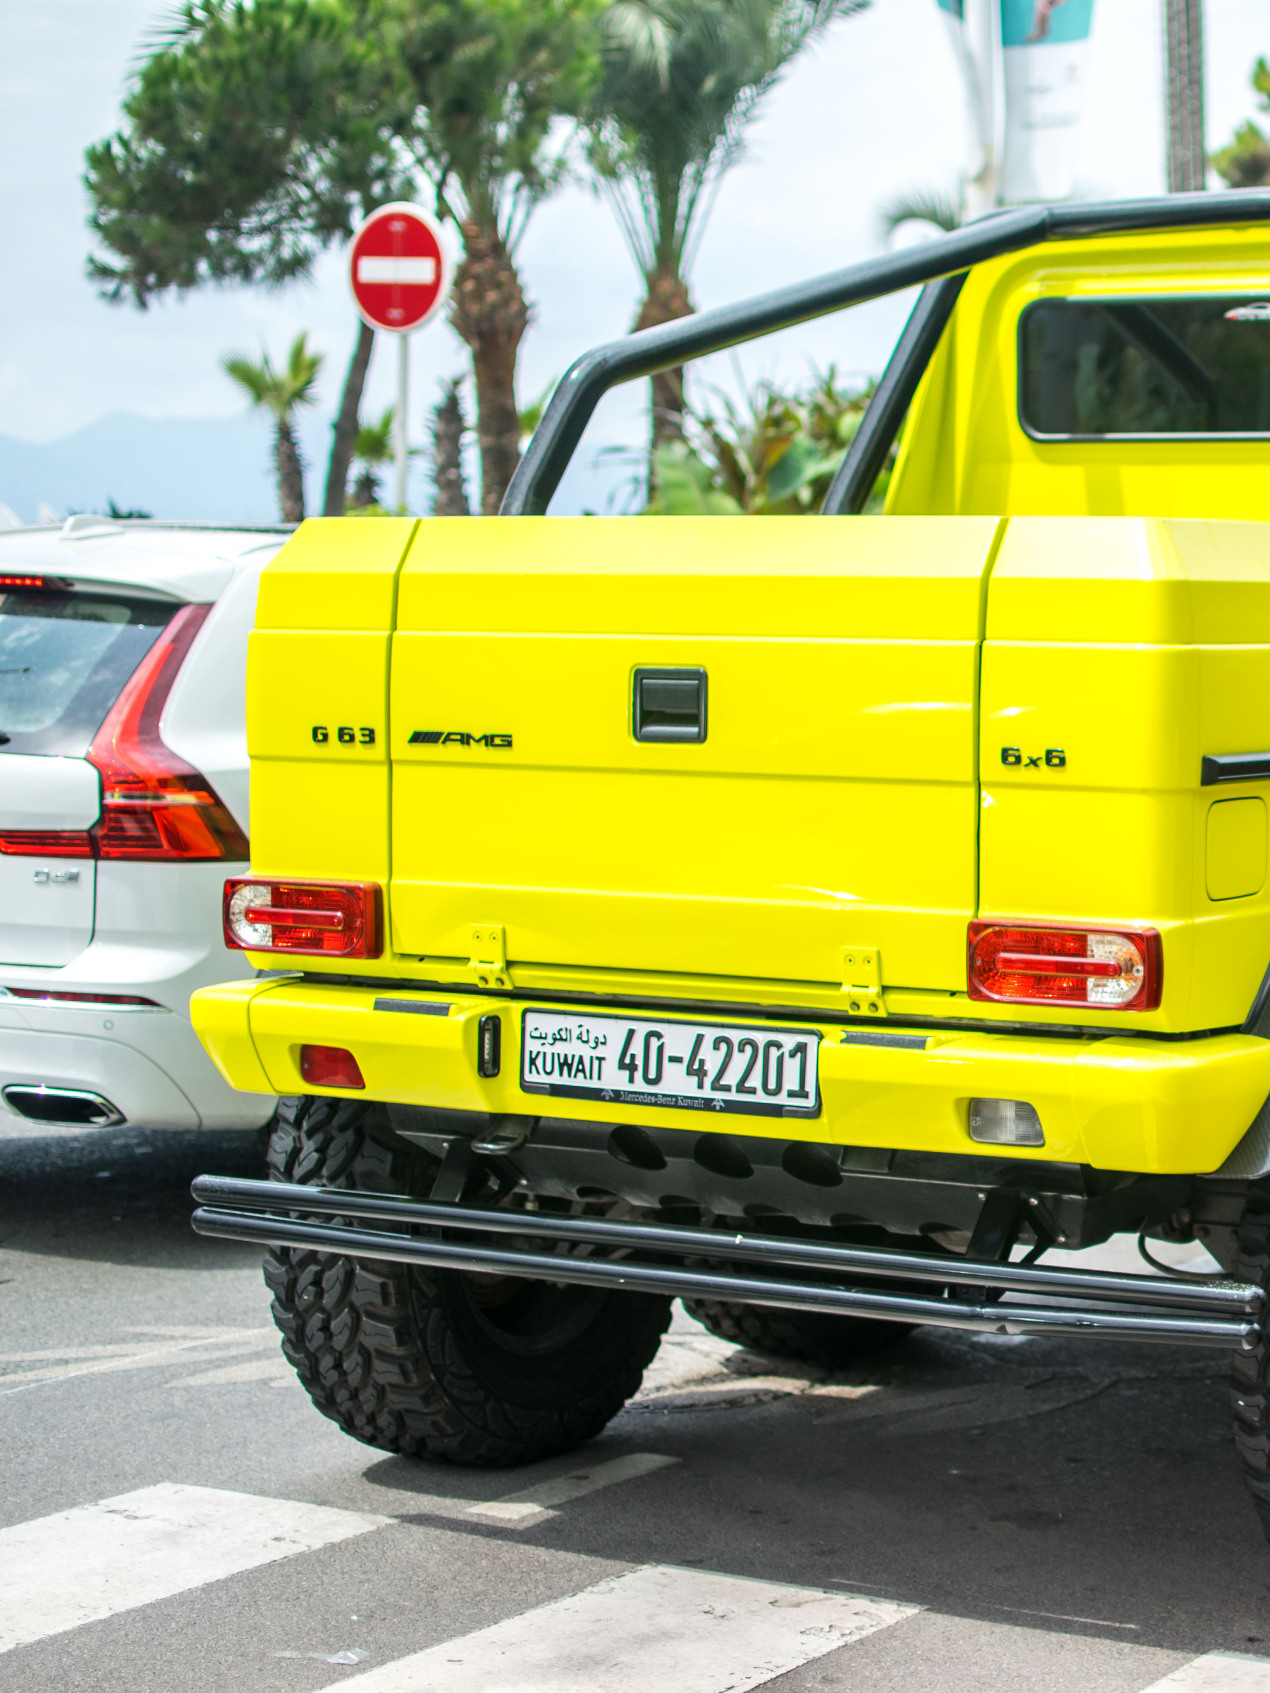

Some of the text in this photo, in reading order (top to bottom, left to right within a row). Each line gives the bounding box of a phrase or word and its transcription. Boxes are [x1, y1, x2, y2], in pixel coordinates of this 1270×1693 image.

[312, 726, 375, 743] G 63
[441, 732, 512, 747] AMG
[529, 1024, 606, 1049] دولة الكويت
[529, 1050, 606, 1081] KUWAIT
[618, 1028, 810, 1099] 40-42201
